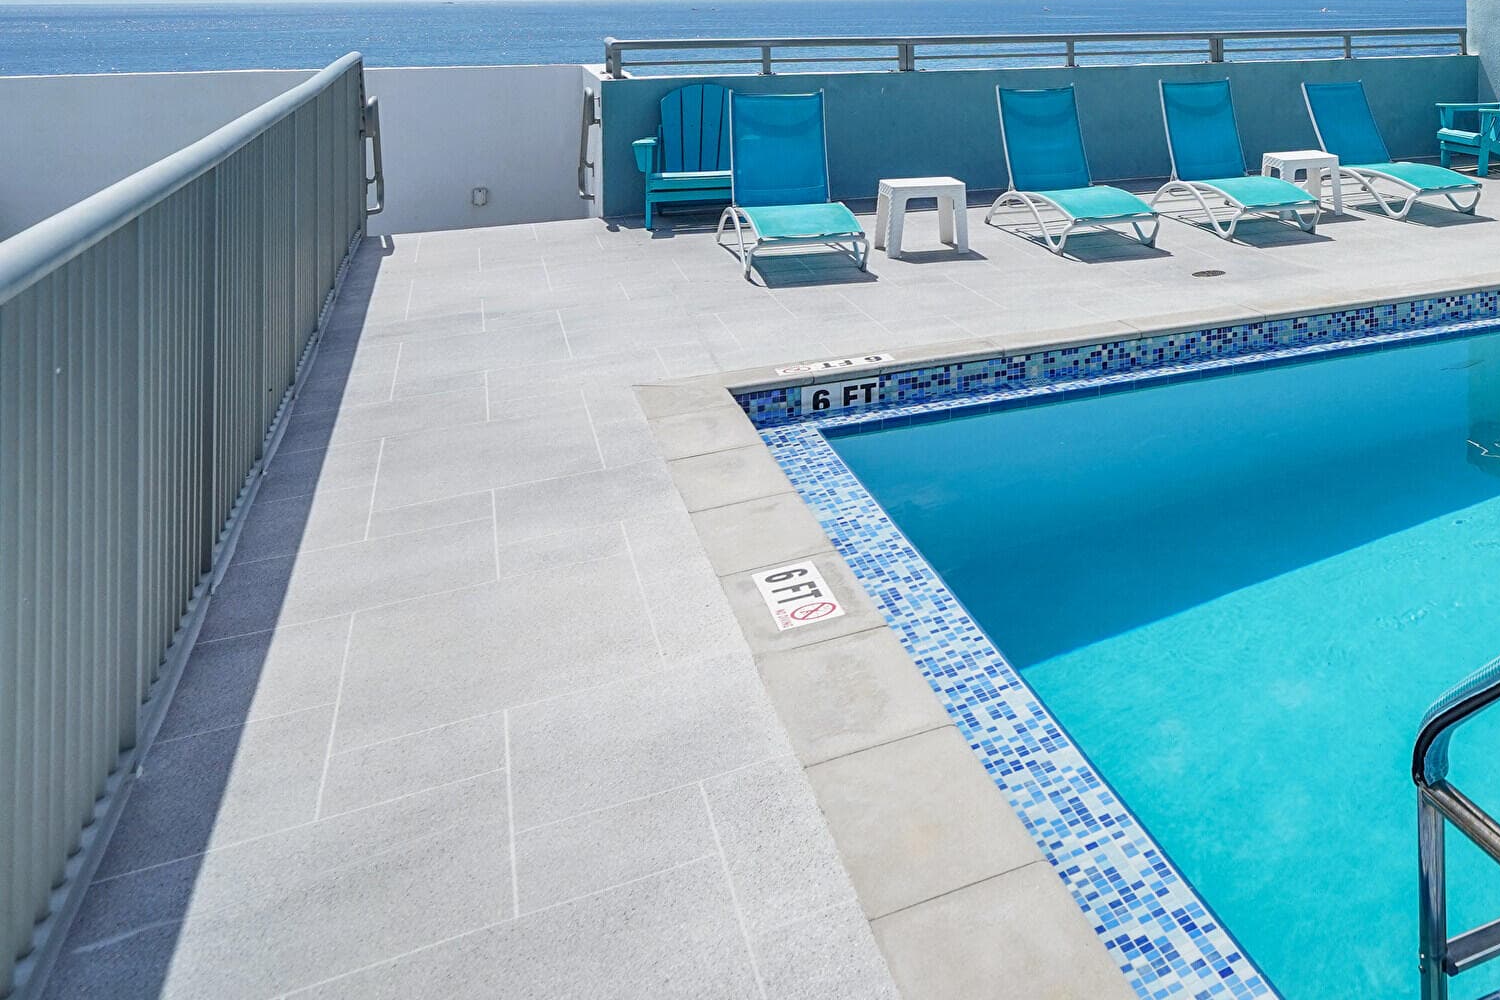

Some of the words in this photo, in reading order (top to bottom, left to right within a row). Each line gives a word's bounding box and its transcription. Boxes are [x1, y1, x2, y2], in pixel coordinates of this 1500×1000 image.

[812, 389, 830, 411] 6
[843, 382, 877, 406] FT
[764, 568, 808, 583] 6
[772, 580, 823, 604] FT
